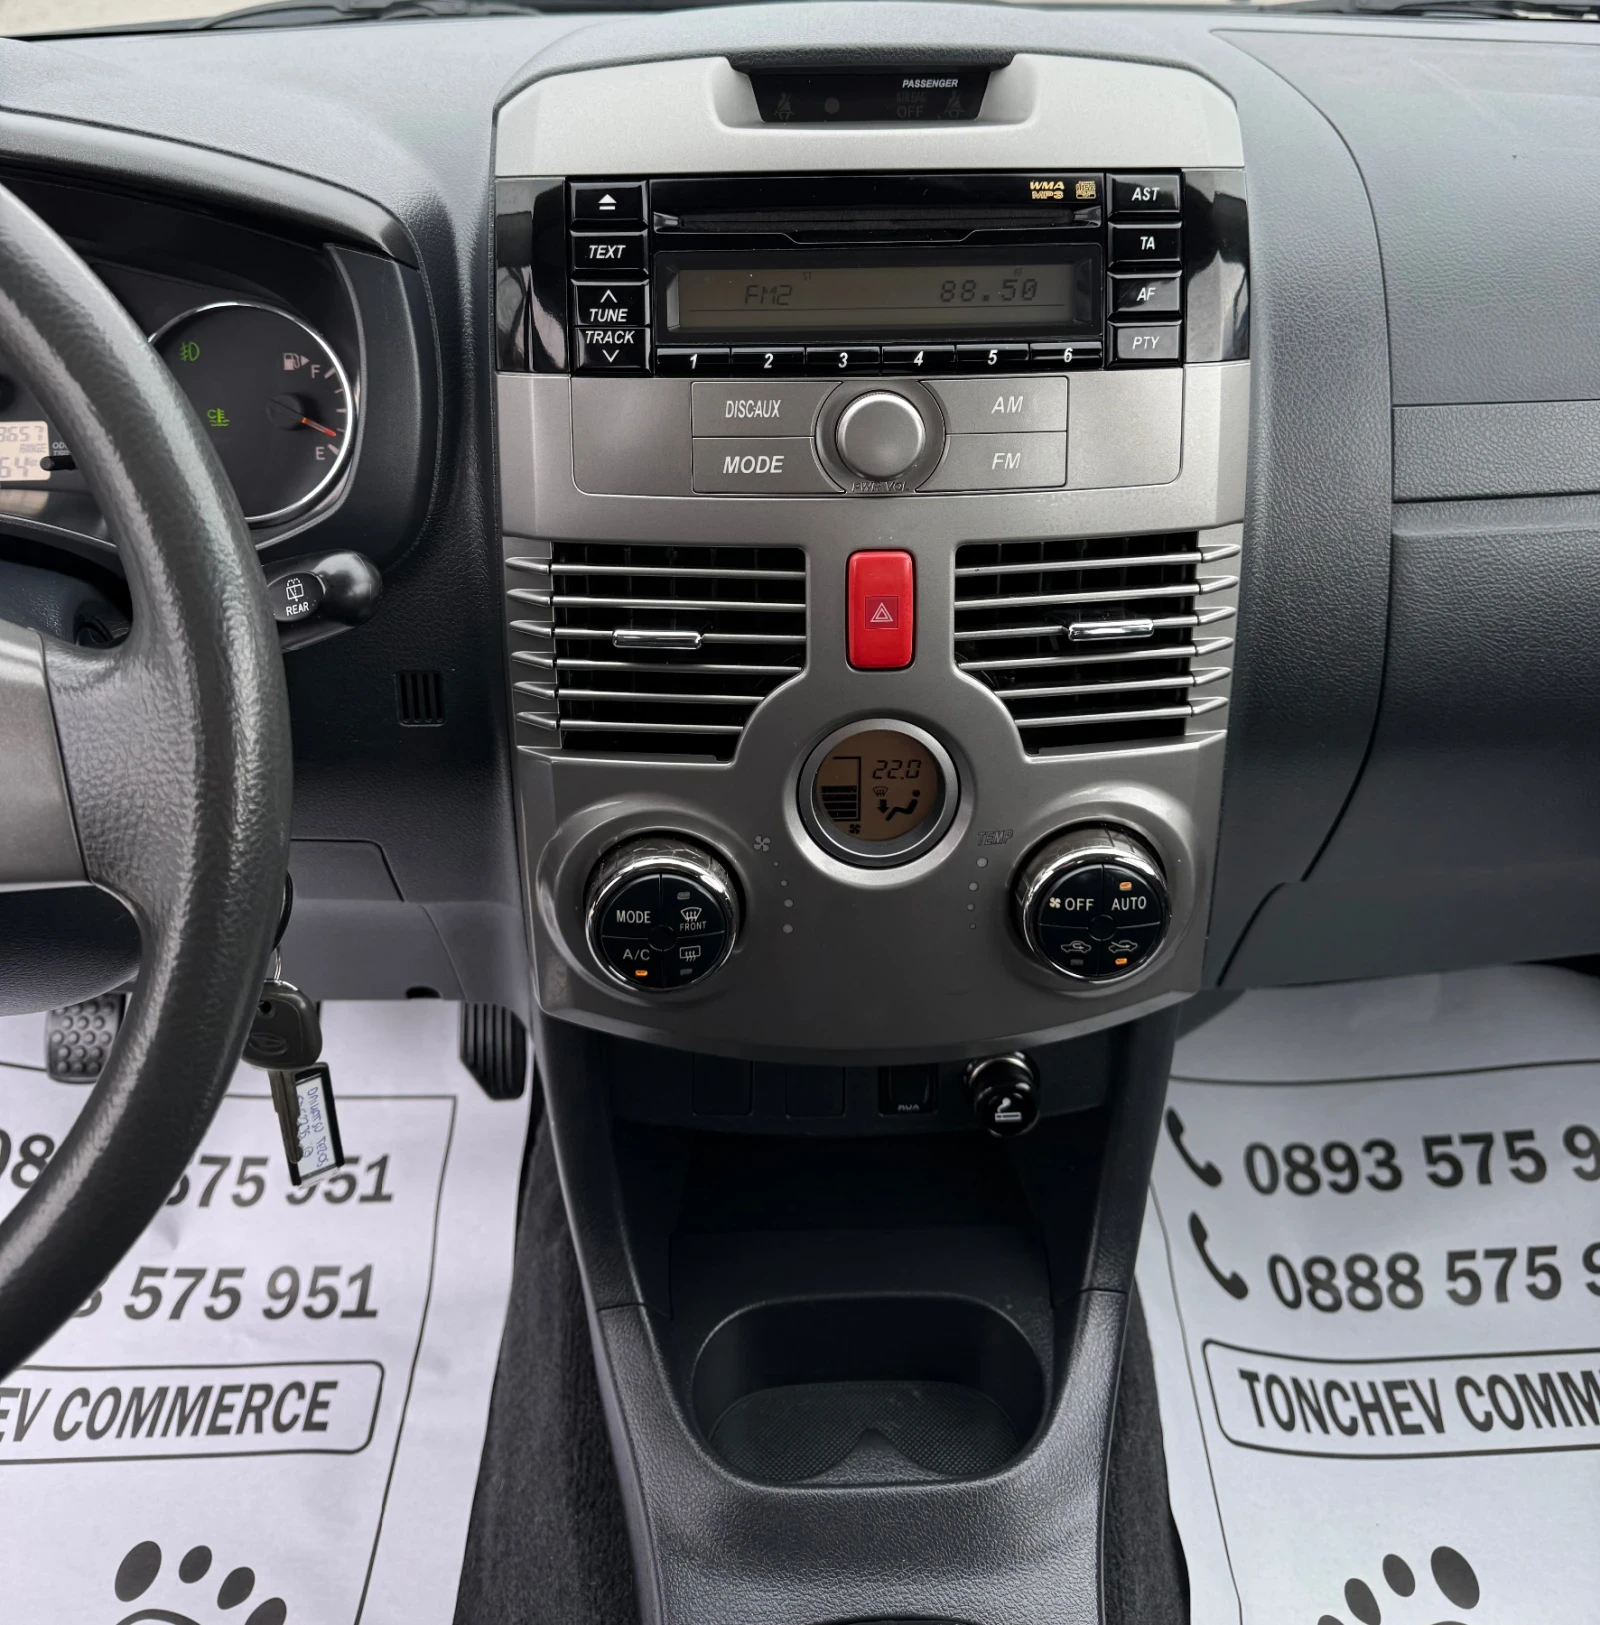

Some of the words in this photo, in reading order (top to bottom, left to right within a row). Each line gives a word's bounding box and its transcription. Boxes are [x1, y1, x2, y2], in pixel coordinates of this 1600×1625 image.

[902, 78, 959, 89] PASSENGER
[897, 105, 925, 118] OFF
[1029, 181, 1065, 190] WMA
[1031, 190, 1064, 200] MP3
[1131, 187, 1160, 201] AST
[1140, 236, 1156, 250] TA
[588, 245, 626, 260] TEXT
[744, 284, 793, 306] FM2
[940, 278, 1038, 303] 88.50
[1137, 287, 1156, 301] AF
[588, 308, 628, 322] TUNE
[585, 330, 635, 345] TRACK
[1132, 336, 1160, 350] PTY
[689, 354, 698, 369] 1
[763, 353, 774, 369] 2
[837, 352, 848, 368] 3
[913, 351, 924, 366] 4
[988, 350, 998, 365] 5
[1063, 347, 1074, 363] 6
[311, 364, 320, 379] F
[991, 395, 1024, 414] AM
[315, 446, 325, 460] E
[723, 455, 785, 474] MODE
[991, 452, 1022, 471] FM
[286, 601, 310, 616] REAR
[872, 759, 922, 780] 22.0
[977, 829, 1014, 847] TEMP
[1064, 897, 1095, 911] OFF
[1111, 896, 1147, 911] AUTO
[616, 909, 651, 924] MODE
[679, 920, 707, 932] FRONT
[622, 948, 650, 961] A/C
[1243, 1137, 1404, 1196] 0893
[1421, 1128, 1548, 1188] 575
[1267, 1251, 1425, 1313] 0888
[1446, 1245, 1562, 1306] 575
[124, 1265, 246, 1321] 575
[262, 1263, 379, 1321] 951
[1237, 1367, 1447, 1438] TONCHEV
[1455, 1370, 1600, 1433] COMM
[53, 1380, 338, 1442] COMMERCE
